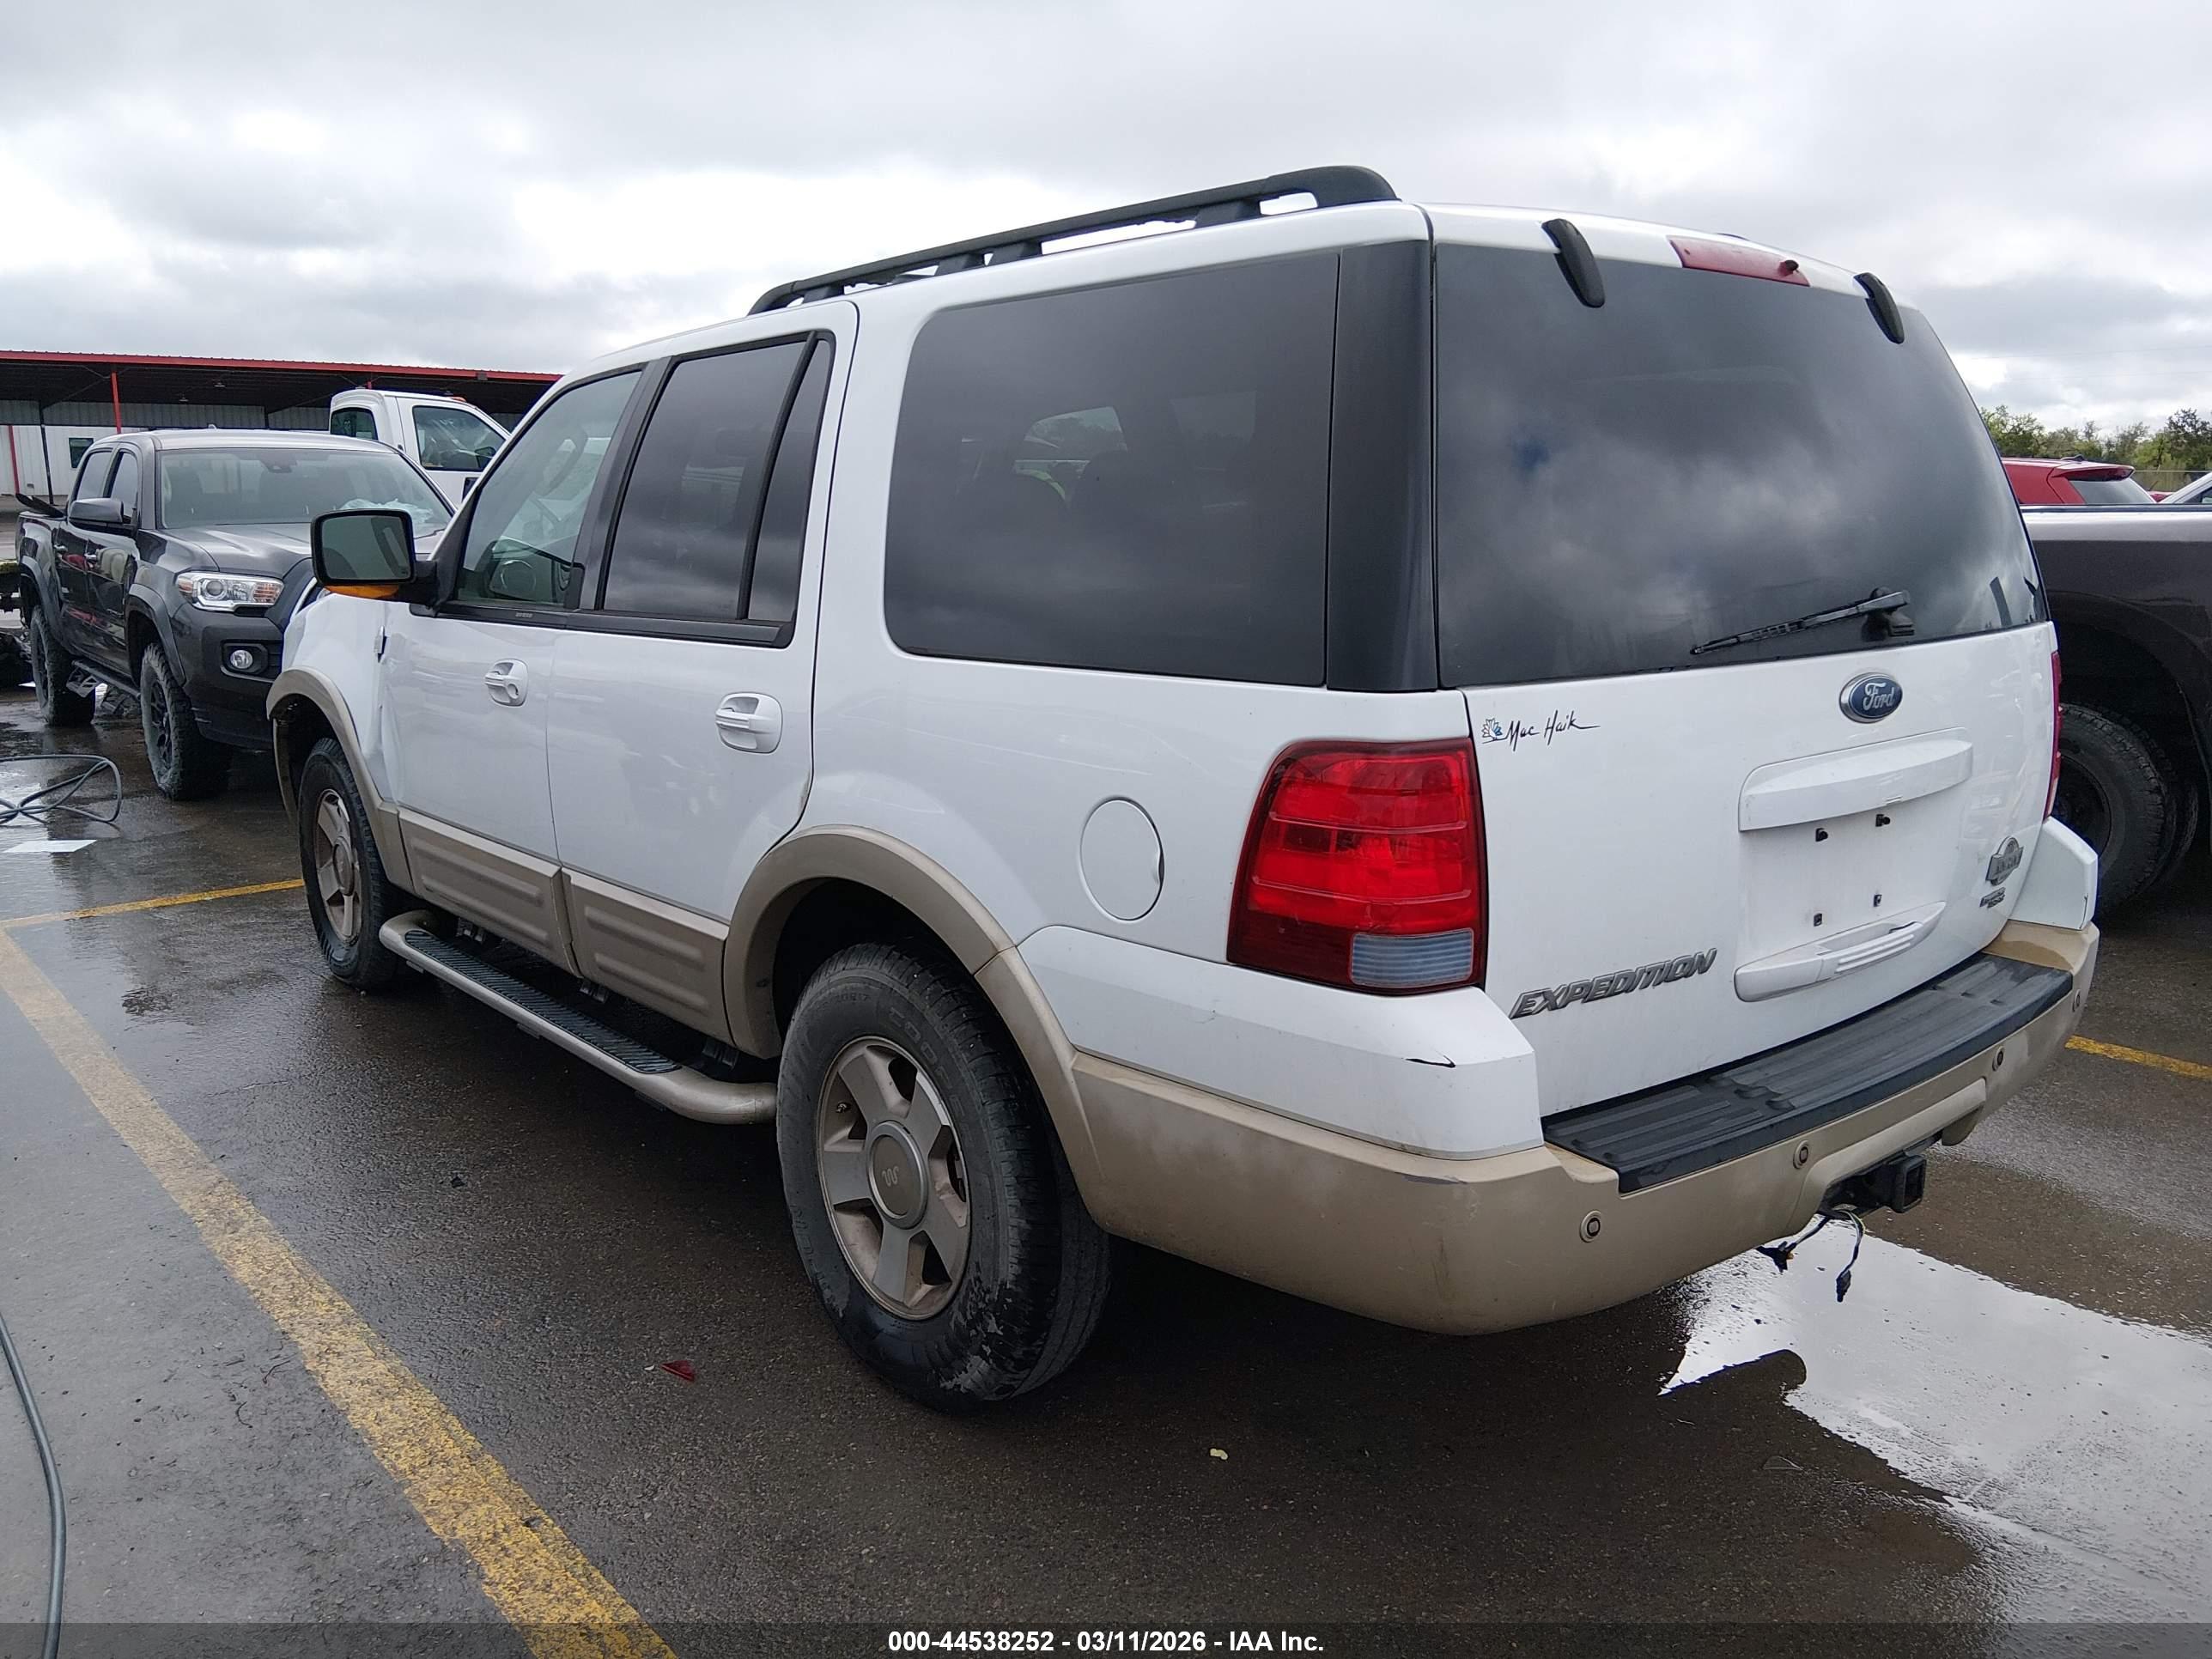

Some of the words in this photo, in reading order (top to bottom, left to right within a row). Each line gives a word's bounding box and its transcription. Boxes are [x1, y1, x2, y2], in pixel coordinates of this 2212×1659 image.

[1863, 682, 1895, 711] Ford
[1504, 720, 1540, 752] Mac
[1544, 709, 1601, 746] Haik
[1509, 948, 1718, 1020] EXPEDITION
